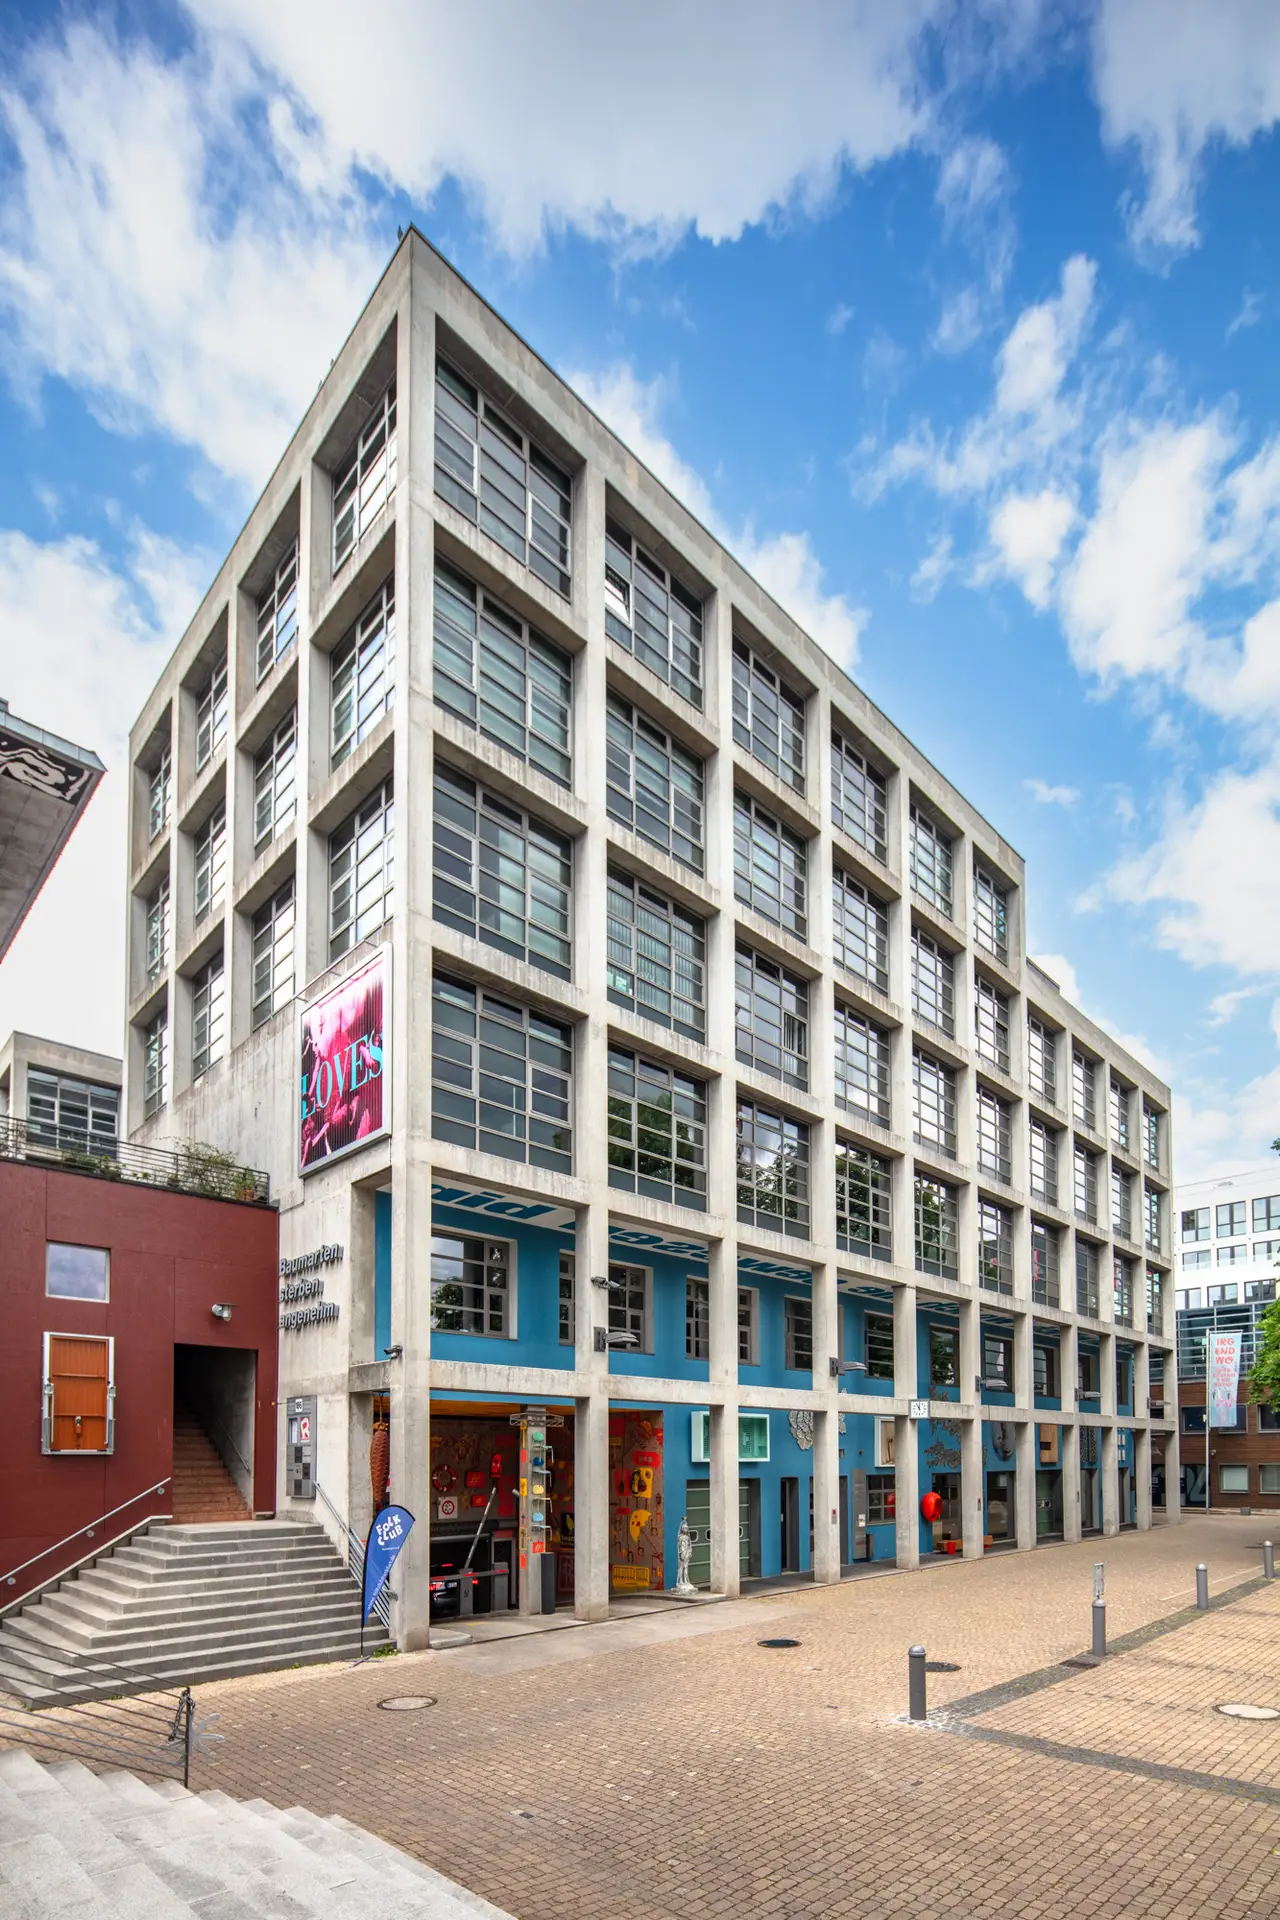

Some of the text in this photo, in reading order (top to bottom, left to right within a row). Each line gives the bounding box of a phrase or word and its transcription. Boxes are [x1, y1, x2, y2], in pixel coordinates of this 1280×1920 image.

[301, 1031, 383, 1121] LOVES
[280, 1243, 343, 1277] Baumarten
[280, 1278, 323, 1302] sterben
[280, 1301, 339, 1331] angenehm
[1215, 1347, 1235, 1355] END
[1217, 1337, 1234, 1346] IRG
[1216, 1356, 1233, 1364] WO
[376, 1514, 401, 1535] FOLK
[378, 1525, 403, 1546] CLUB
